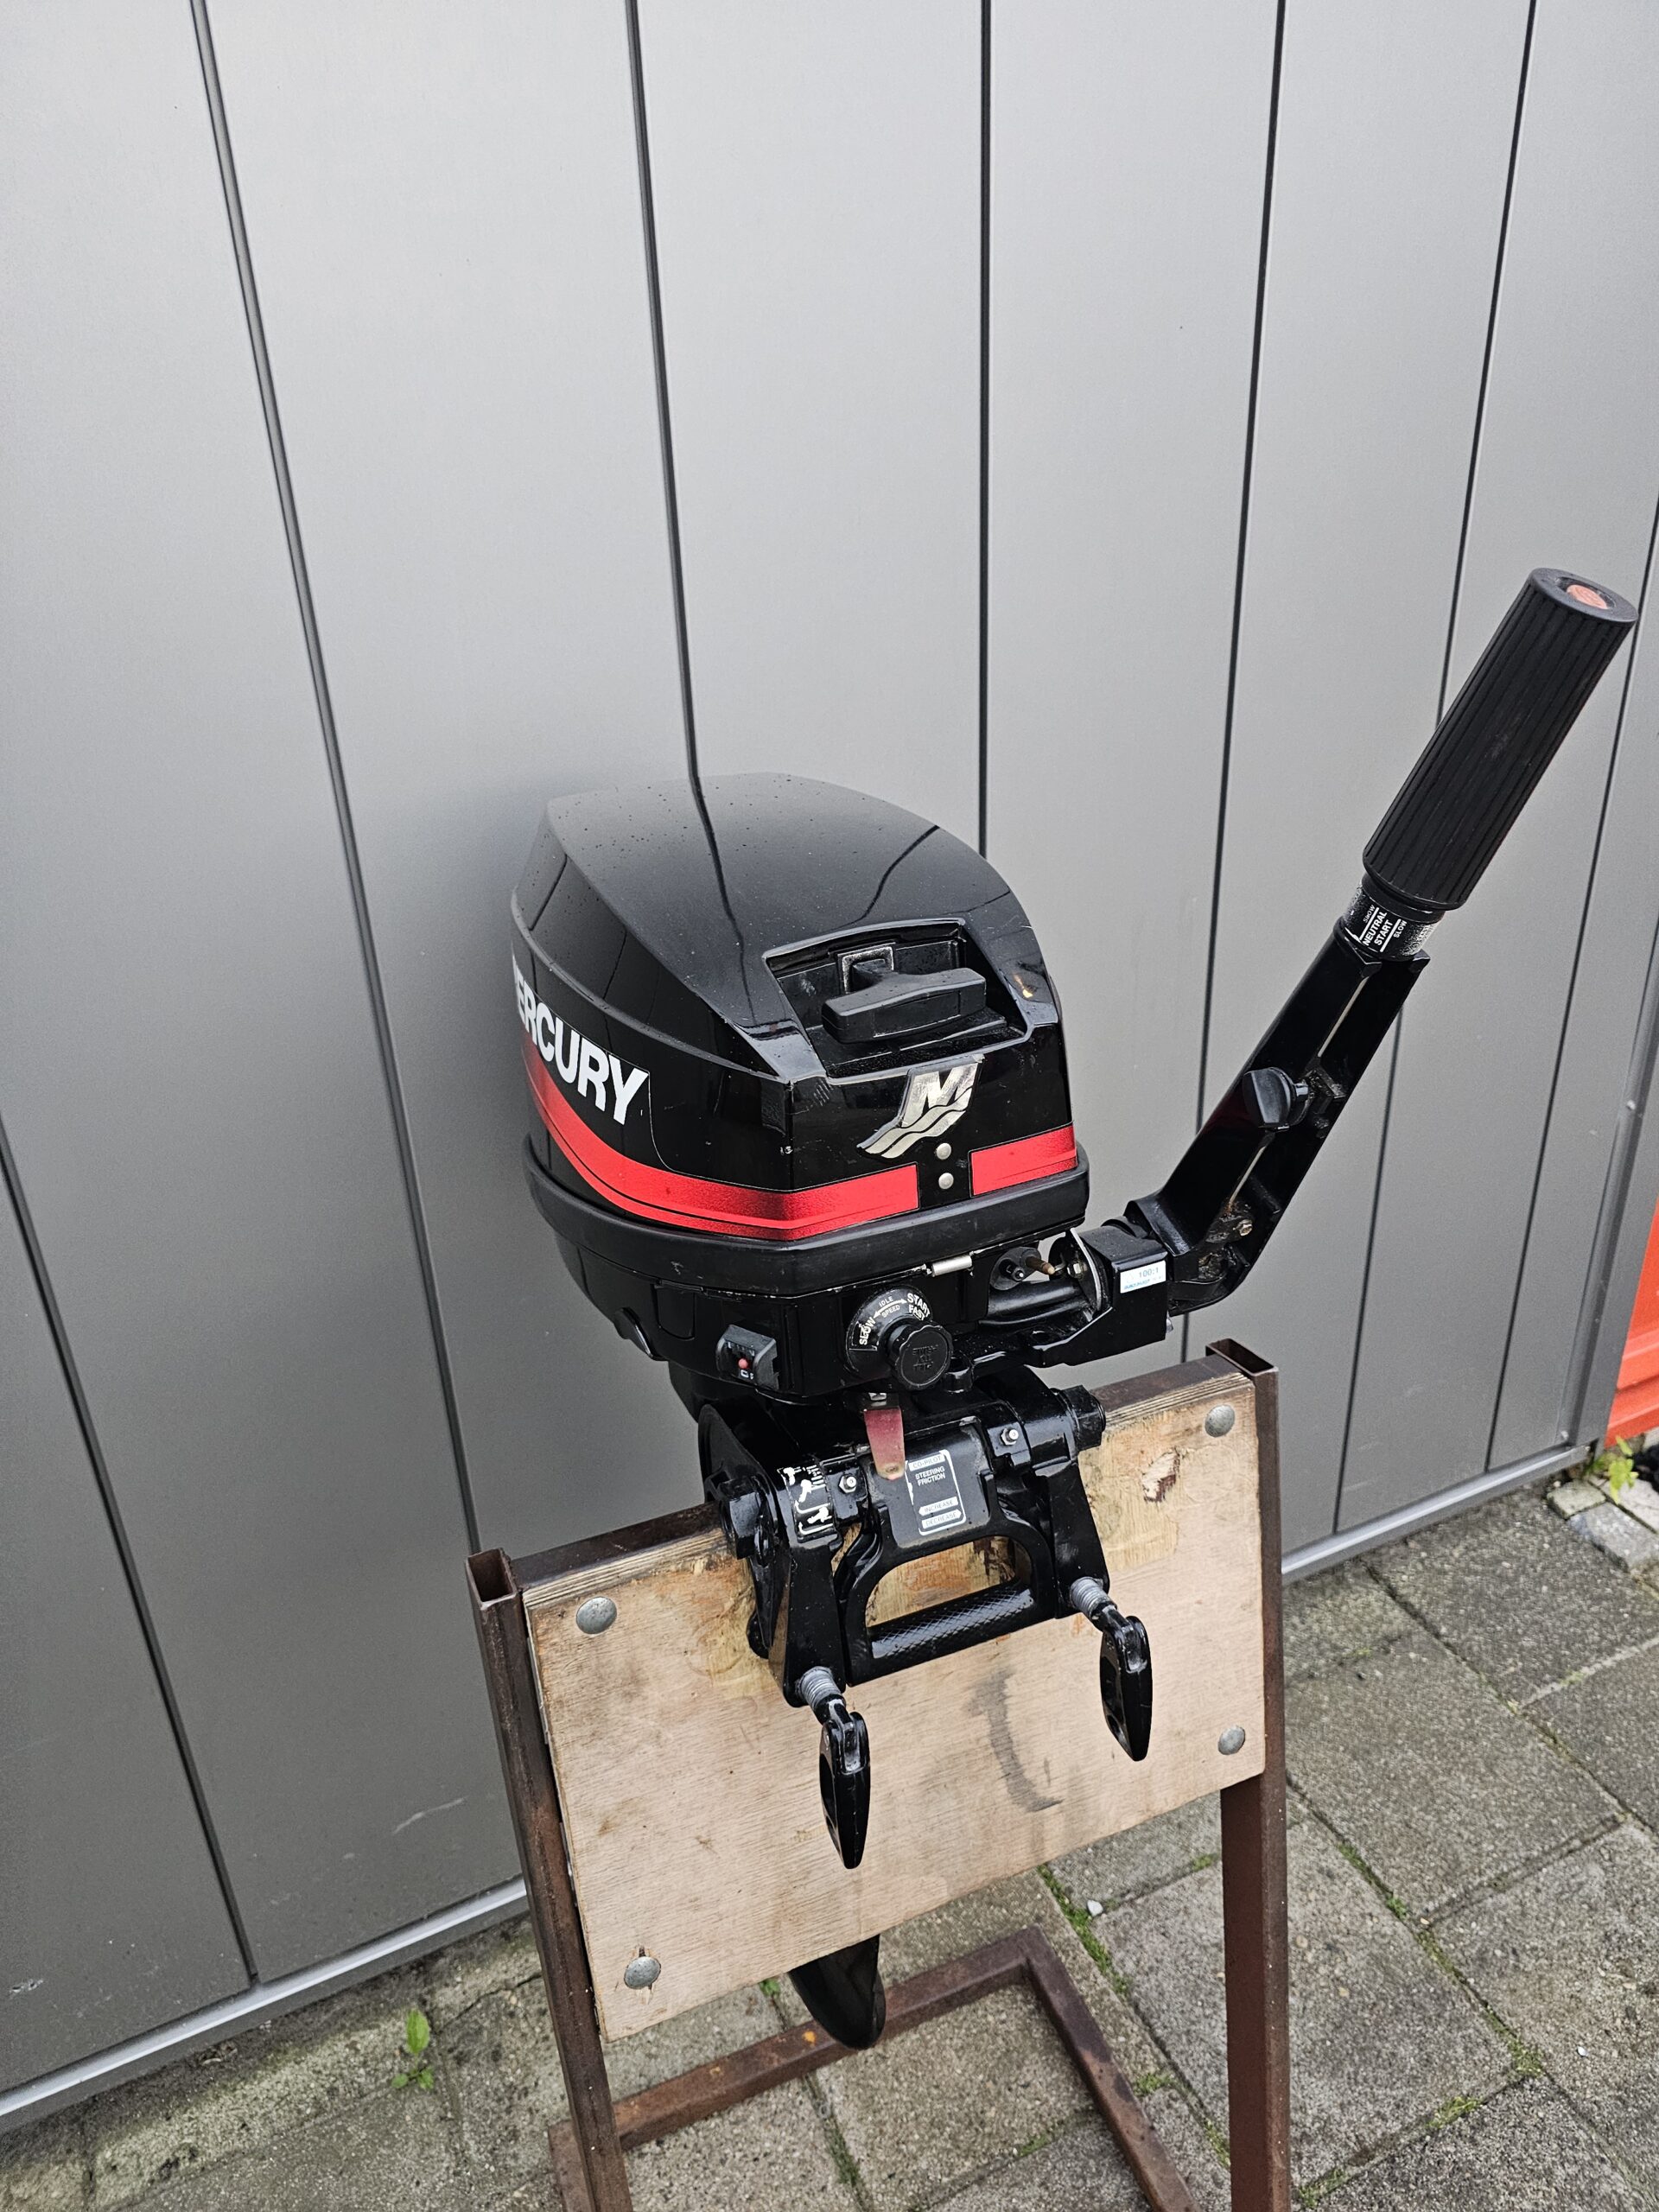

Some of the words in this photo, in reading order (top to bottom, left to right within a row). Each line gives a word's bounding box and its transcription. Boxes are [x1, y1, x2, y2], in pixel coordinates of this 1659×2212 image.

[1362, 912, 1388, 946] NEUTRAL
[1374, 919, 1394, 946] START
[1393, 920, 1408, 938] SLOW
[1139, 1267, 1159, 1278] 100:1
[879, 1296, 893, 1307] IDLE
[906, 1293, 931, 1318] START
[881, 1305, 900, 1319] SPEED
[908, 1305, 925, 1321] FAST
[915, 1466, 945, 1480] STEERING
[917, 1473, 946, 1487] FRICTION
[924, 1500, 954, 1513] INCREASE
[925, 1512, 957, 1527] DECREASE
